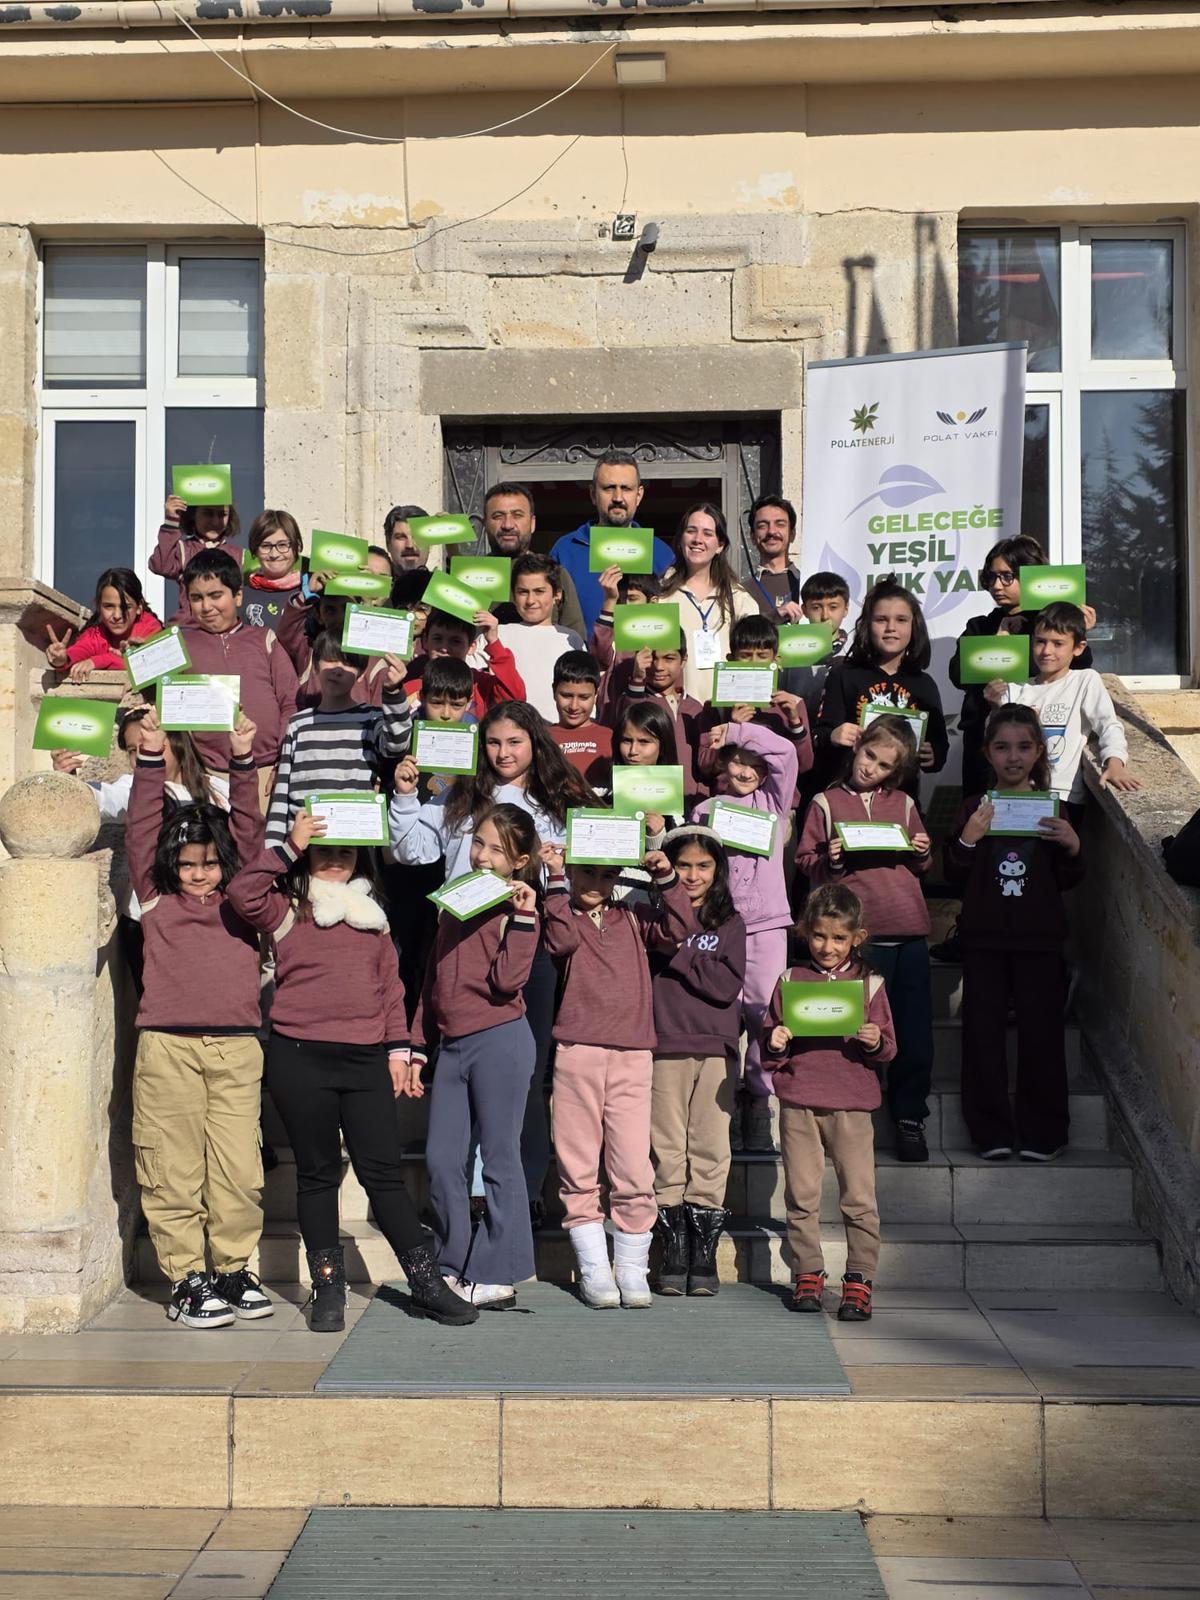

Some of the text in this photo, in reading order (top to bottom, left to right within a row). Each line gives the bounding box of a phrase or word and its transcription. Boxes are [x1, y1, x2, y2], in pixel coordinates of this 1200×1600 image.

[830, 434, 895, 449] POLATENERJİ
[923, 430, 998, 443] POLAT VAKFI
[867, 504, 1004, 534] GELECEĞE
[866, 534, 956, 568] YEŞİL
